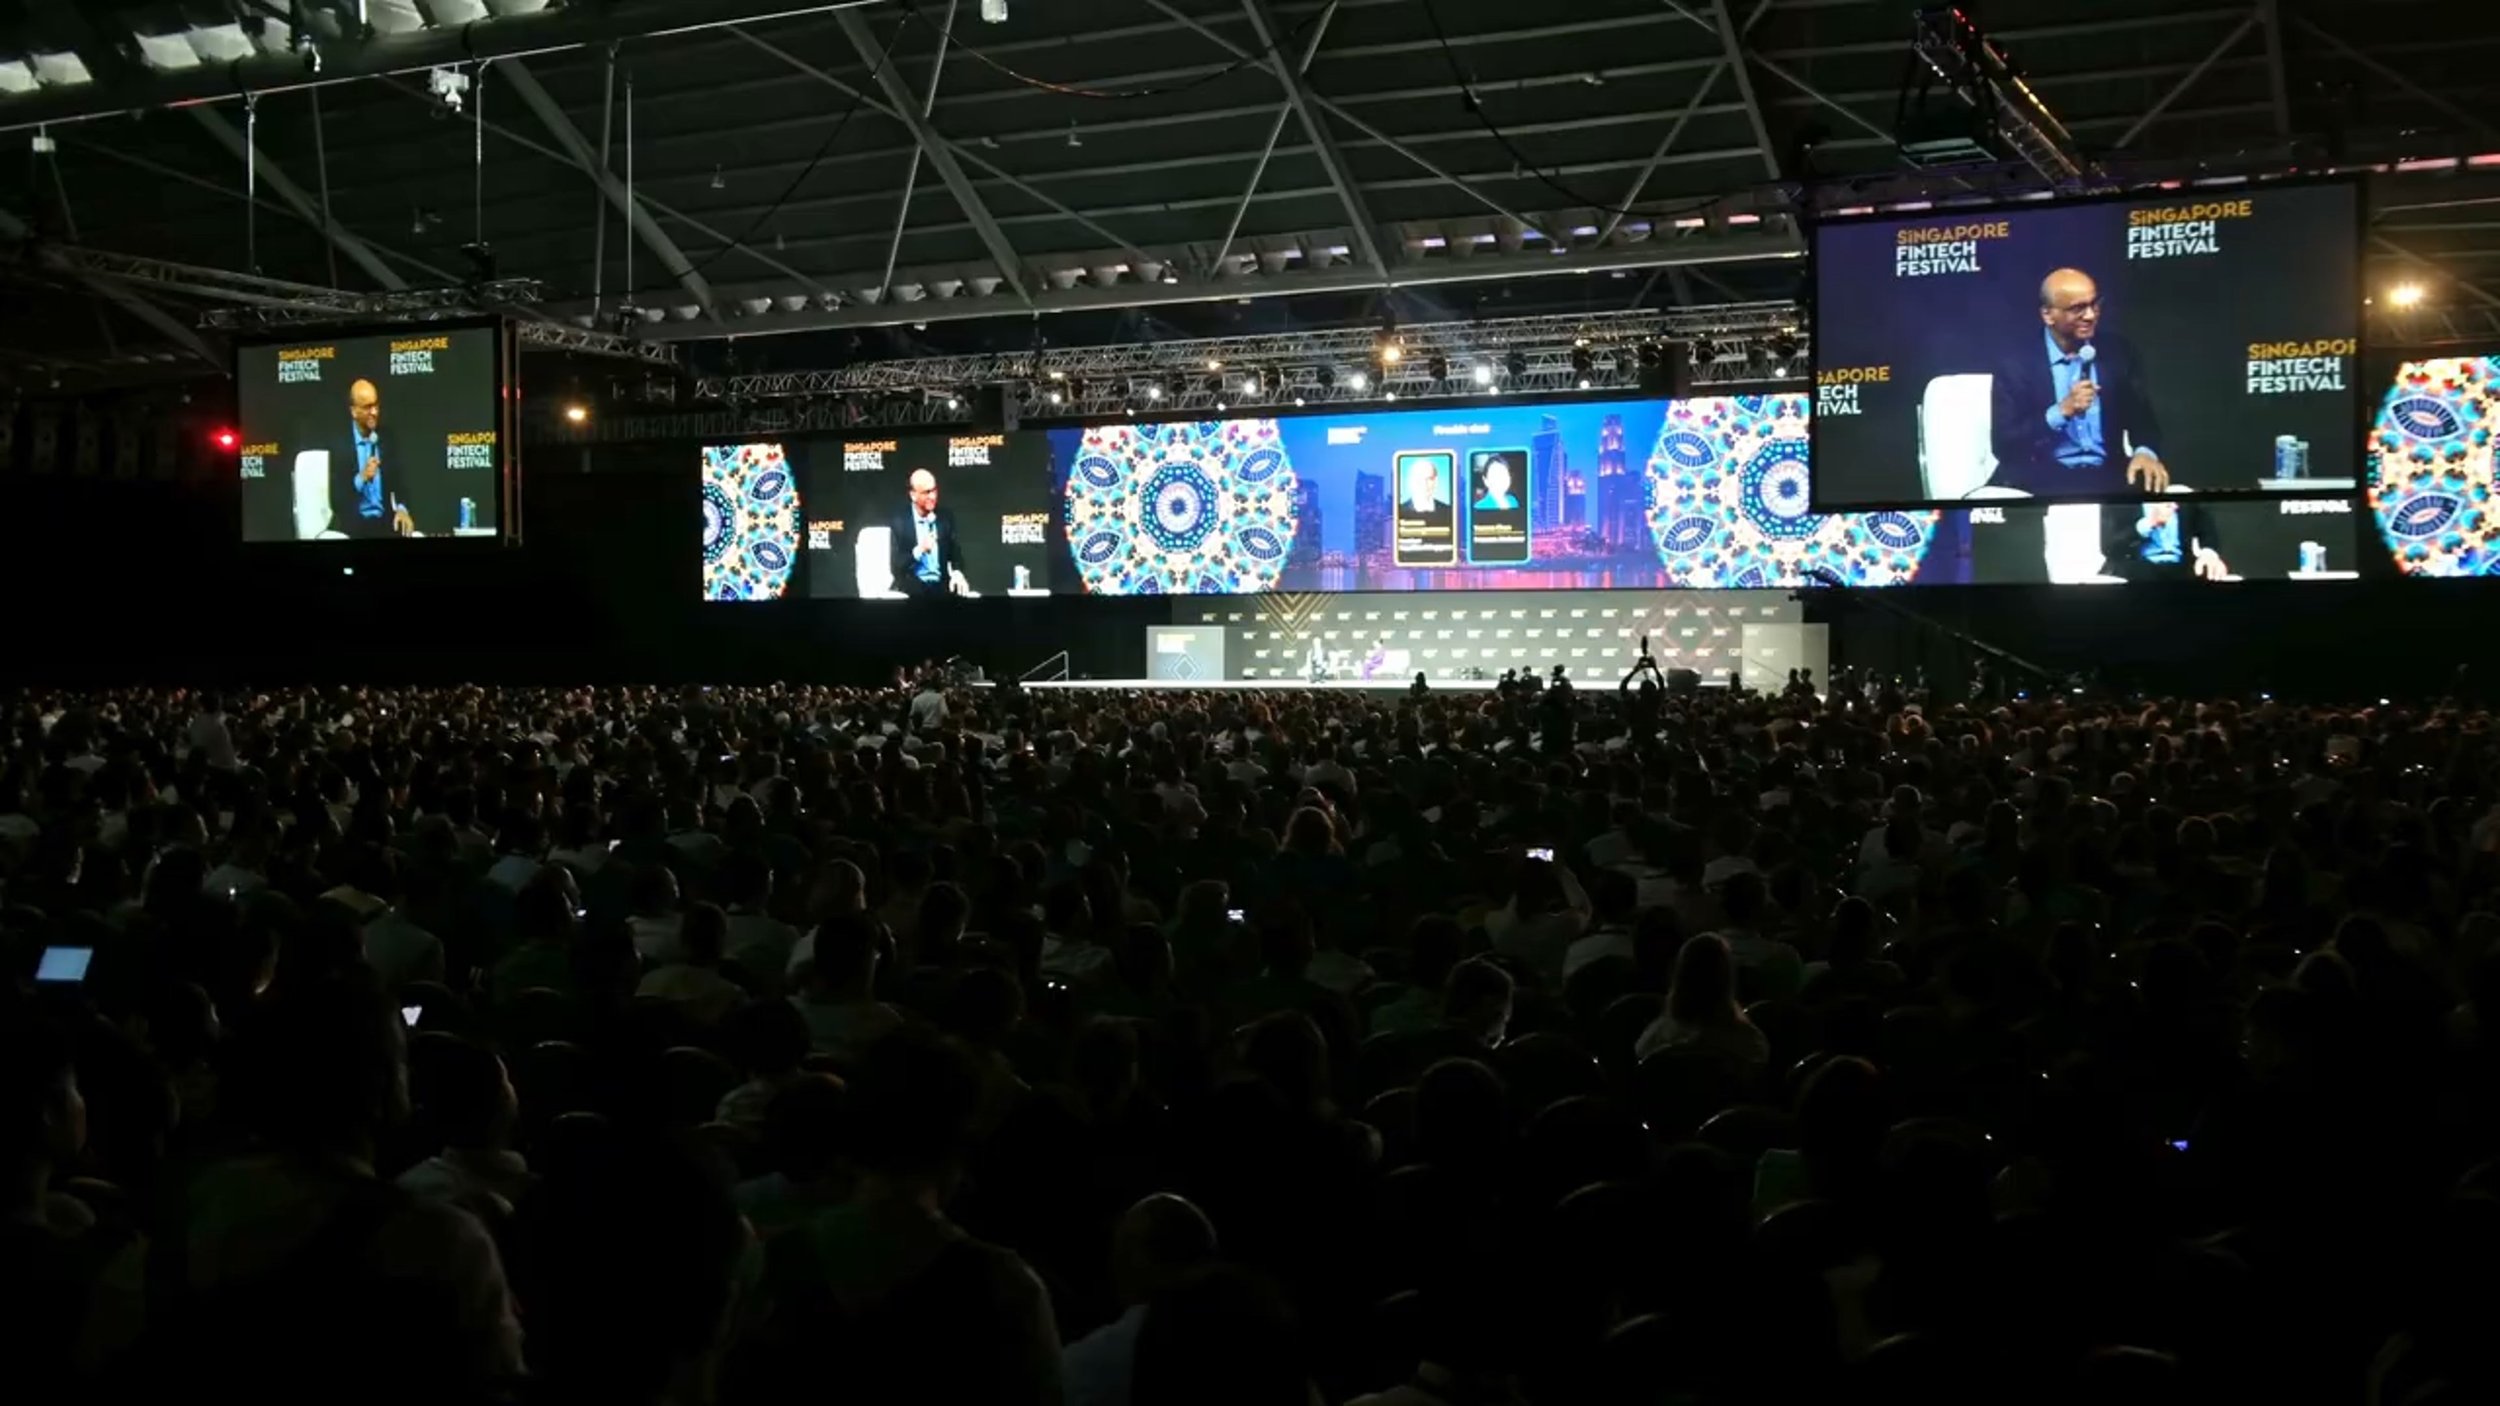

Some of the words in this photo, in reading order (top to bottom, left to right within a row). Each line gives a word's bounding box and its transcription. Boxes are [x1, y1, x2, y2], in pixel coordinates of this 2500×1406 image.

[2128, 220, 2216, 242] FINTECH
[1896, 241, 1977, 261] FINTECH
[2247, 357, 2340, 376] FINTECH
